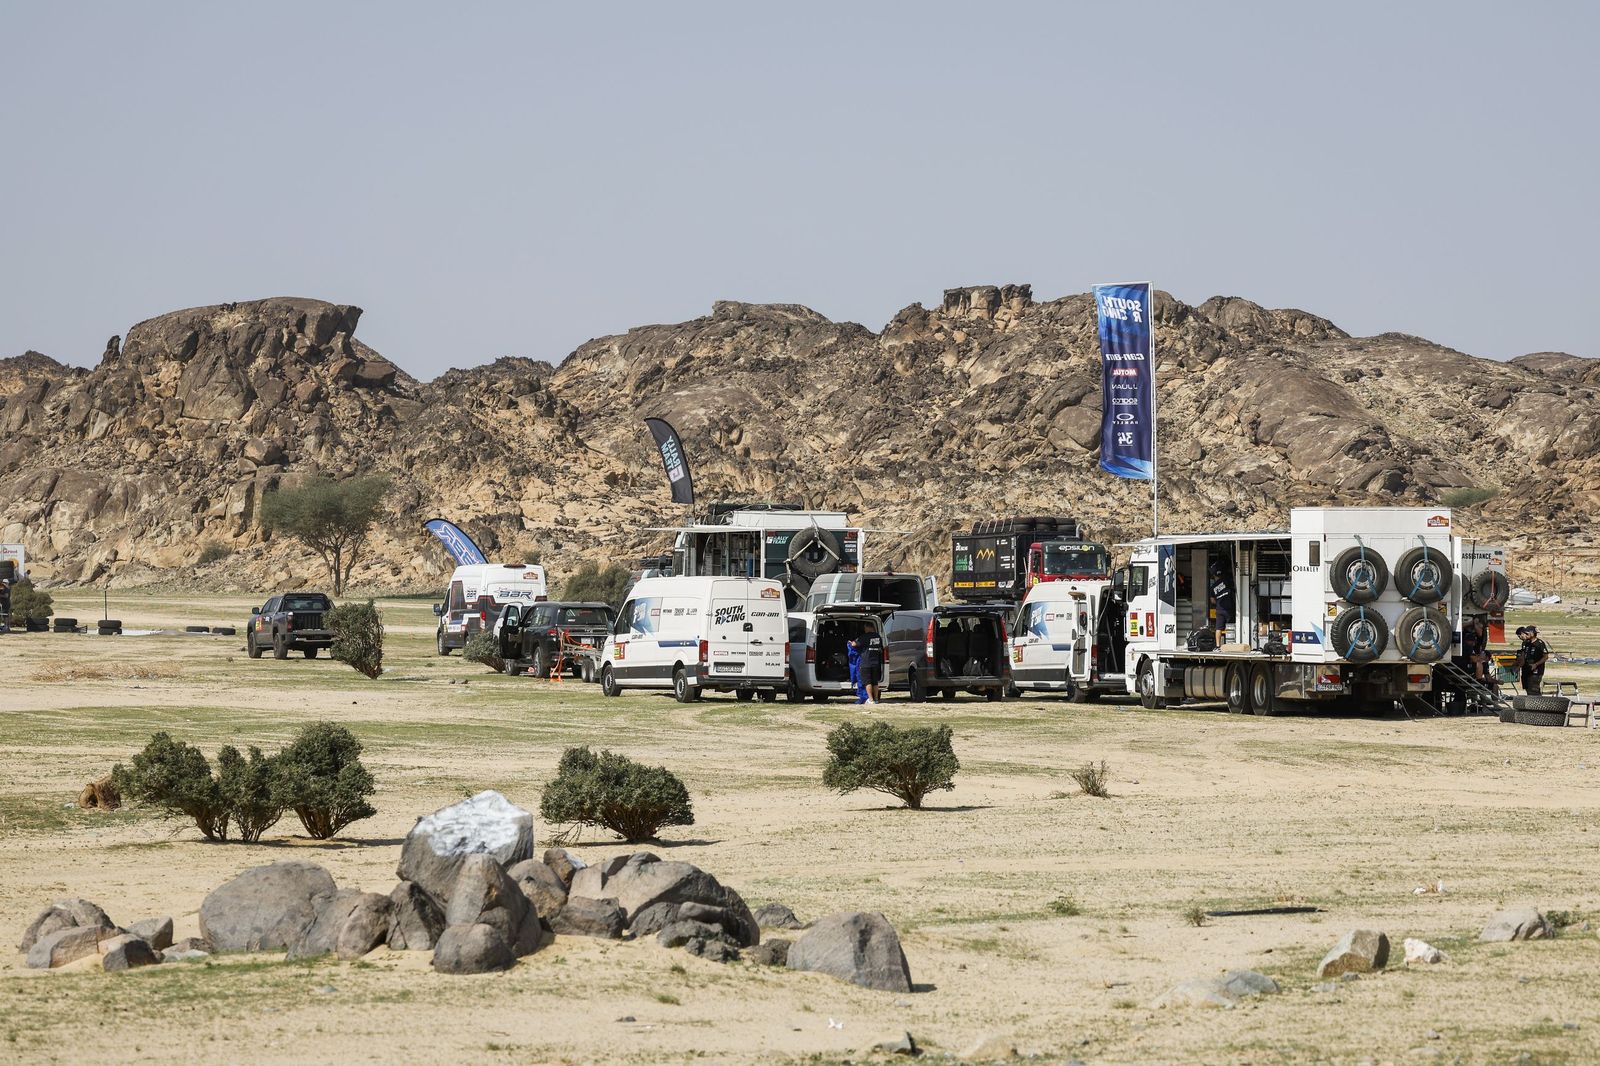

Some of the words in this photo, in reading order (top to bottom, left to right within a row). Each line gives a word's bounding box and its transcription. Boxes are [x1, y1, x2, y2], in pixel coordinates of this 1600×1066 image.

[1059, 544, 1095, 552] epsilon
[499, 590, 533, 600] BBR
[714, 605, 744, 617] SOUTH
